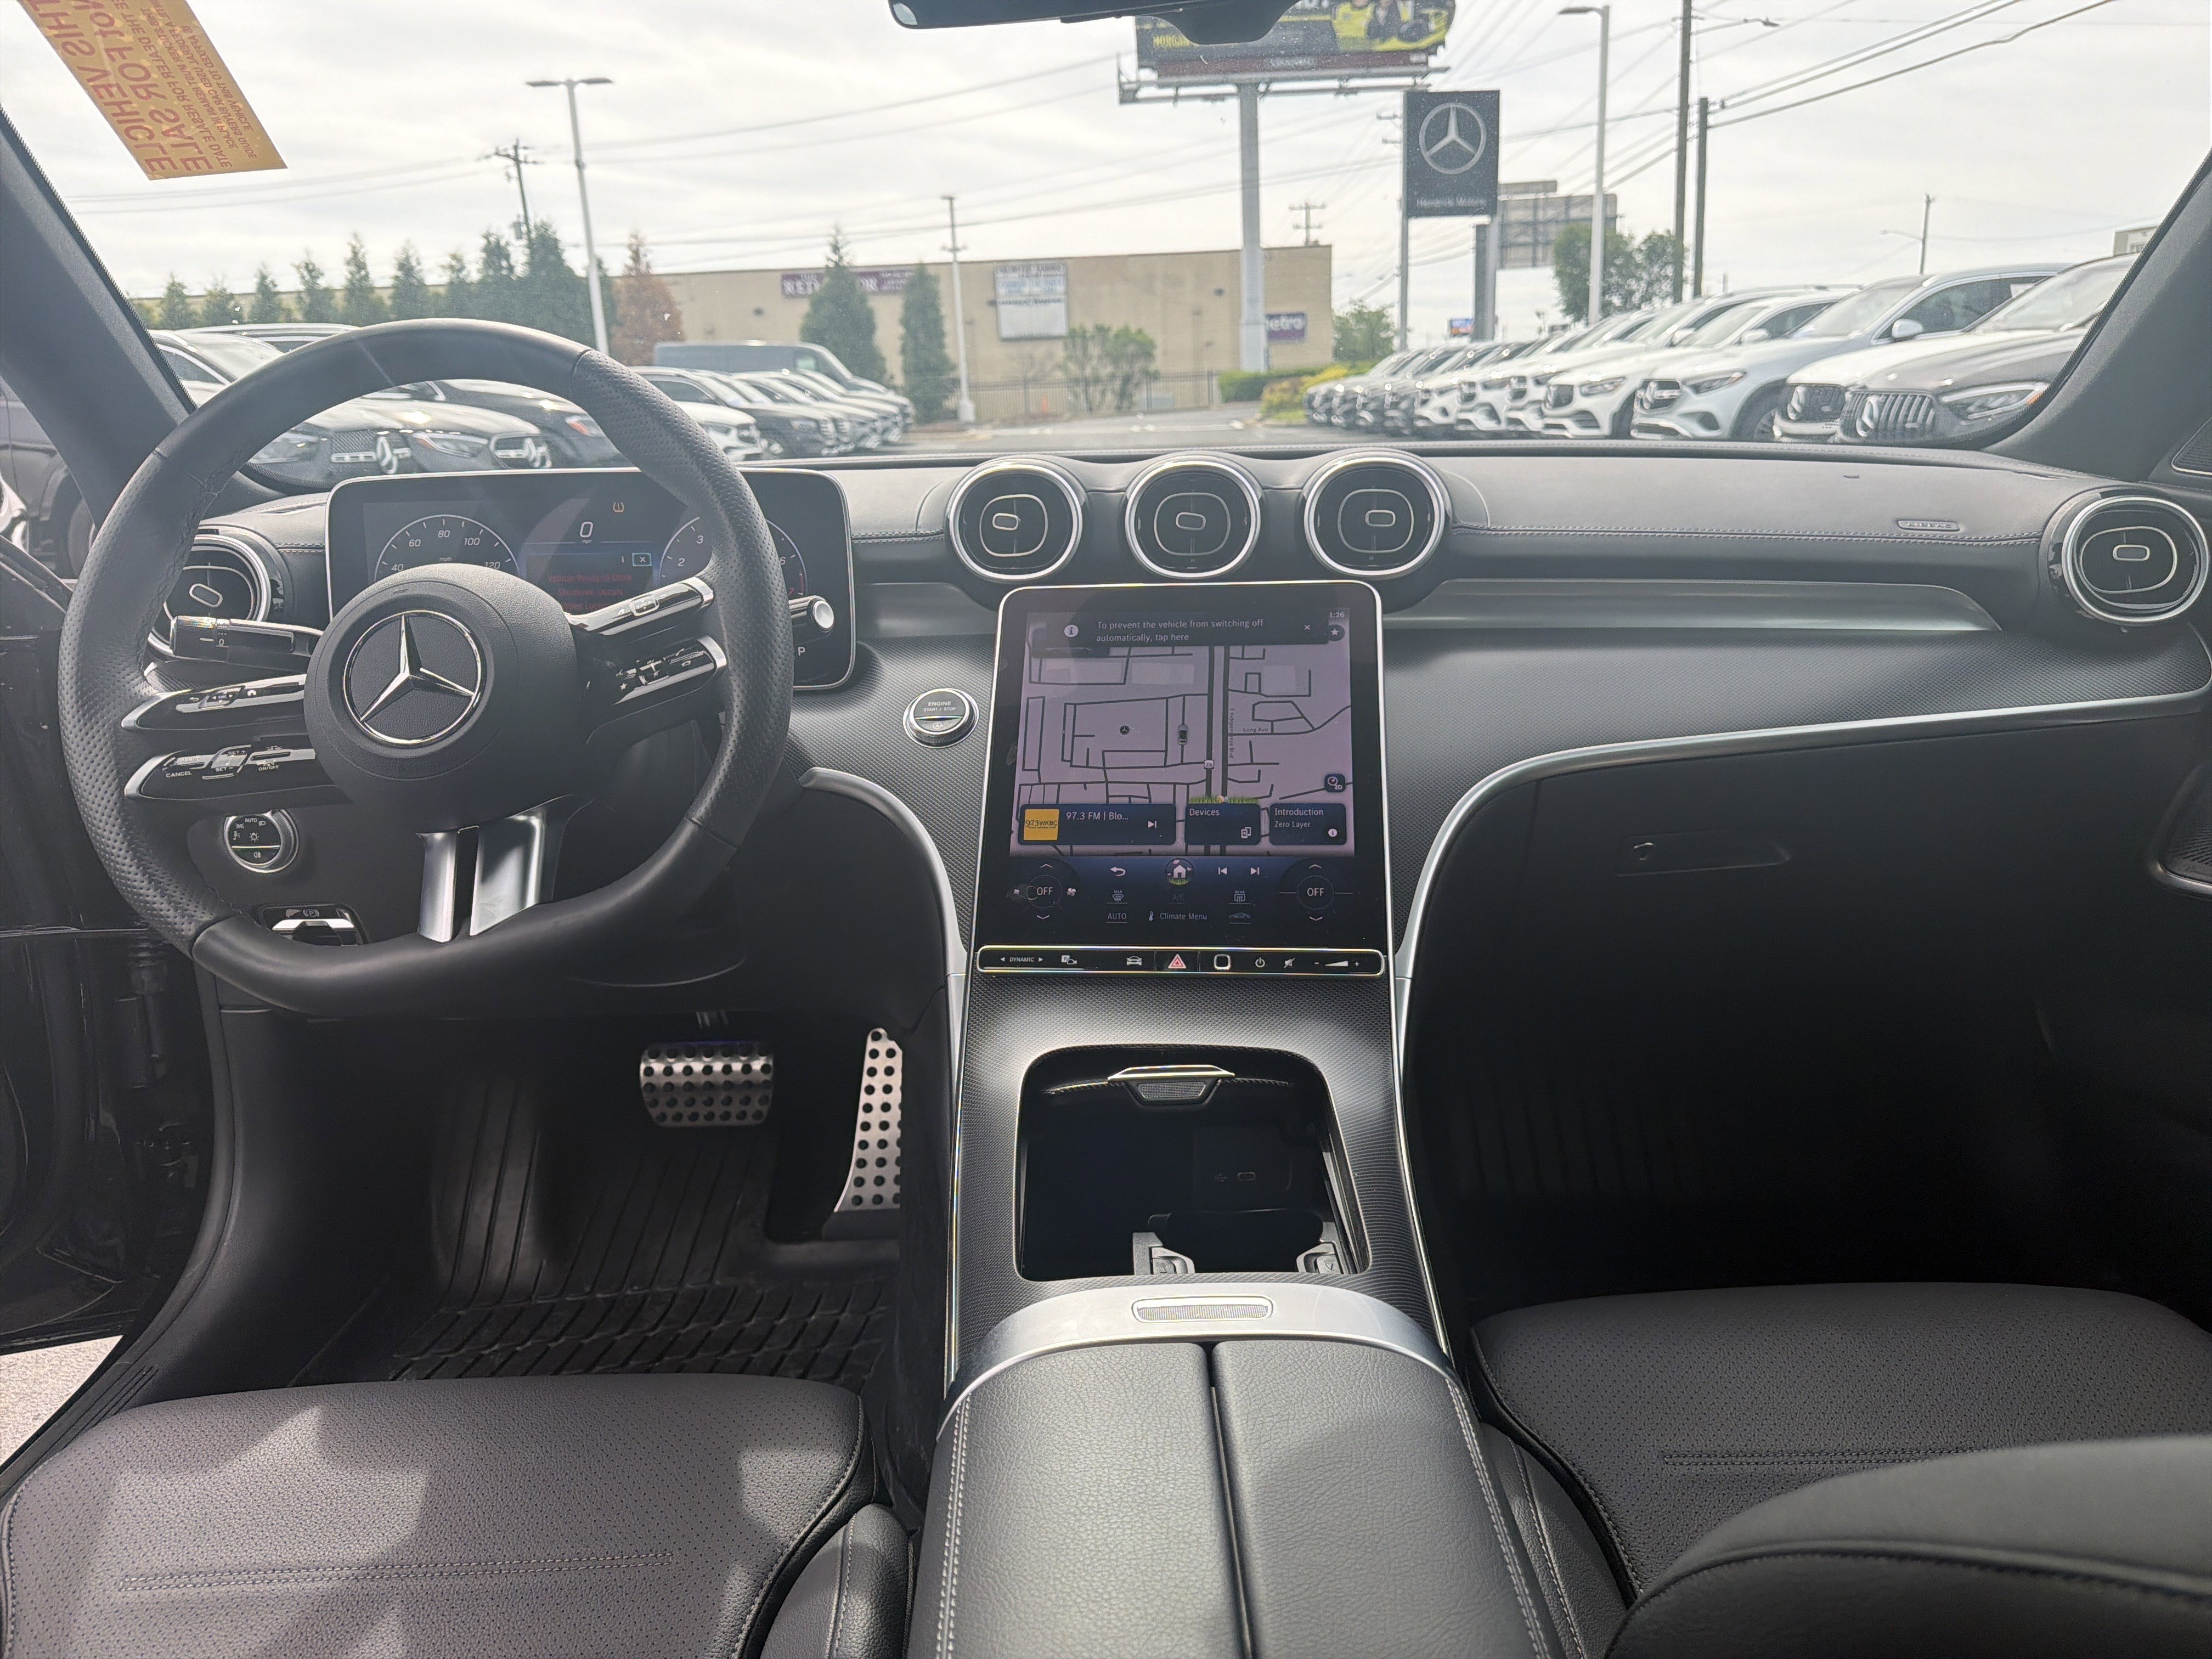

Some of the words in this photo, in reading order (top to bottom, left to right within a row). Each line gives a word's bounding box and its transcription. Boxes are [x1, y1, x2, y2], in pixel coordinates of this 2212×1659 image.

[1265, 315, 1304, 331] etro
[437, 529, 450, 538] 80
[579, 521, 594, 538] 0
[409, 539, 421, 547] 60
[464, 538, 481, 546] 100
[696, 535, 704, 544] 3
[484, 561, 501, 569] 120
[677, 558, 685, 567] 2
[780, 556, 786, 565] 6
[391, 563, 404, 572] 40
[1109, 622, 1140, 630] prevent
[1211, 619, 1249, 628] switching
[1096, 633, 1153, 642] automatically,
[1155, 634, 1169, 642] tap
[798, 646, 805, 656] P
[1066, 812, 1085, 820] 97.3
[1088, 812, 1101, 820] FM
[1189, 808, 1220, 816] Devices
[1274, 808, 1324, 816] Introduction
[1292, 821, 1311, 829] Layer
[1036, 887, 1053, 895] OFF
[1307, 888, 1324, 897] OFF
